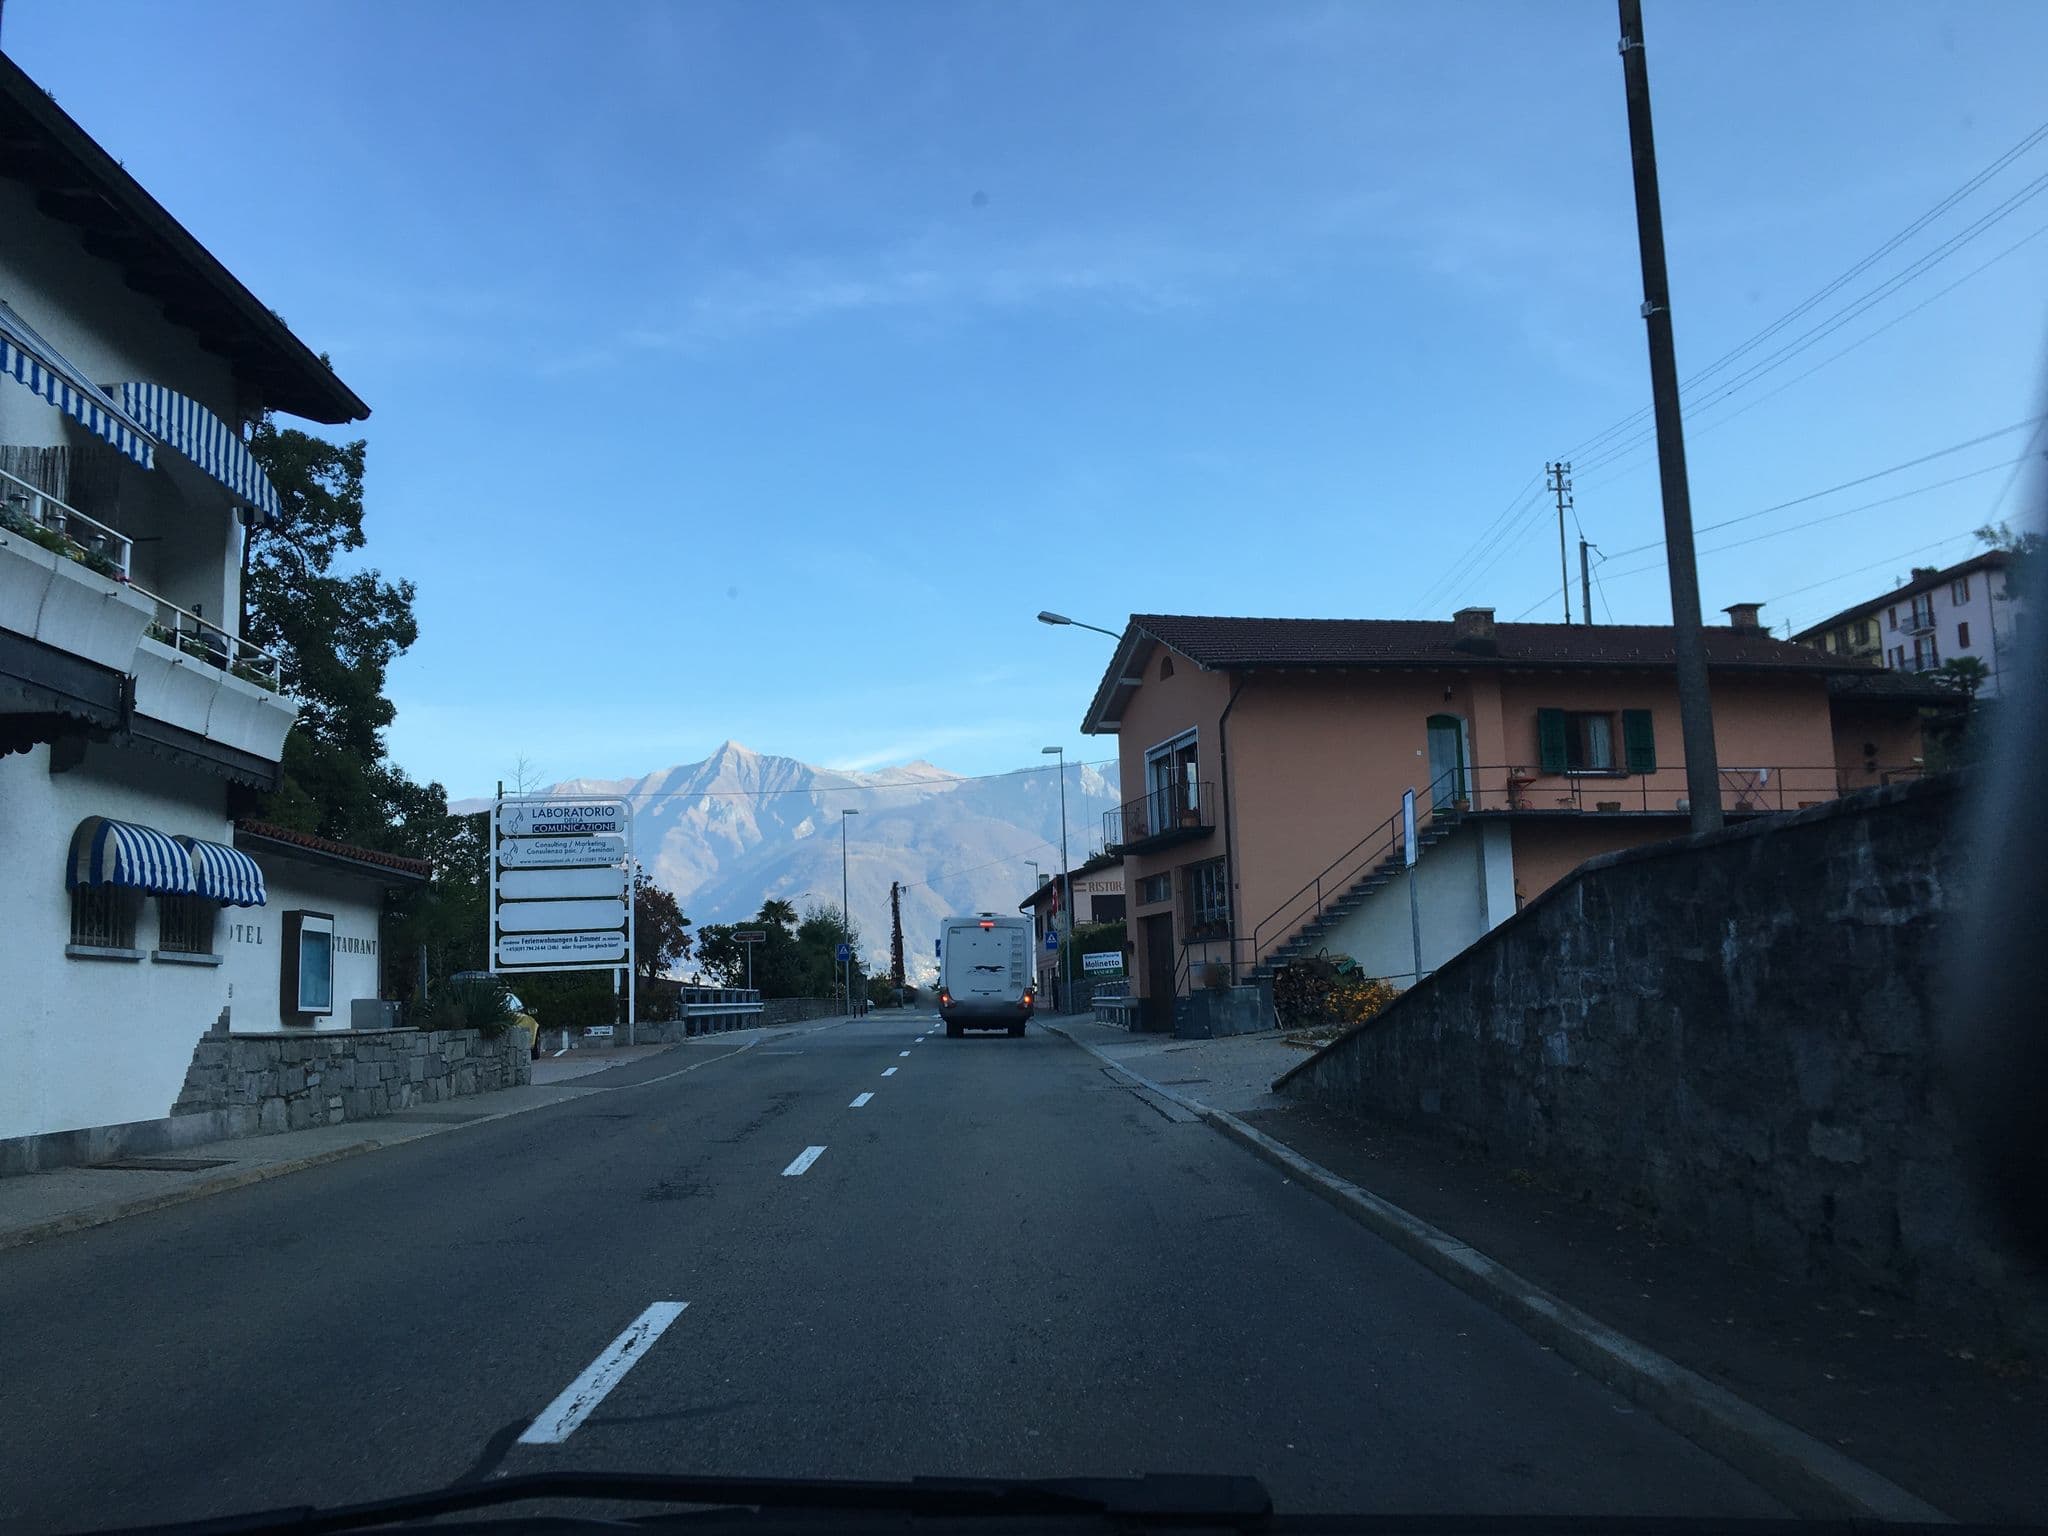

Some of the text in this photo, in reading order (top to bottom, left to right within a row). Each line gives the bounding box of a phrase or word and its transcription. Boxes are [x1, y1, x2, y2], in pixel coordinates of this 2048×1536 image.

[532, 807, 615, 818] LABORATORIO
[533, 822, 616, 833] COMUNICAZIONE
[575, 840, 606, 848] Marketing
[521, 937, 573, 945] Ferienwohnungen
[1085, 959, 1120, 969] Molinetto
